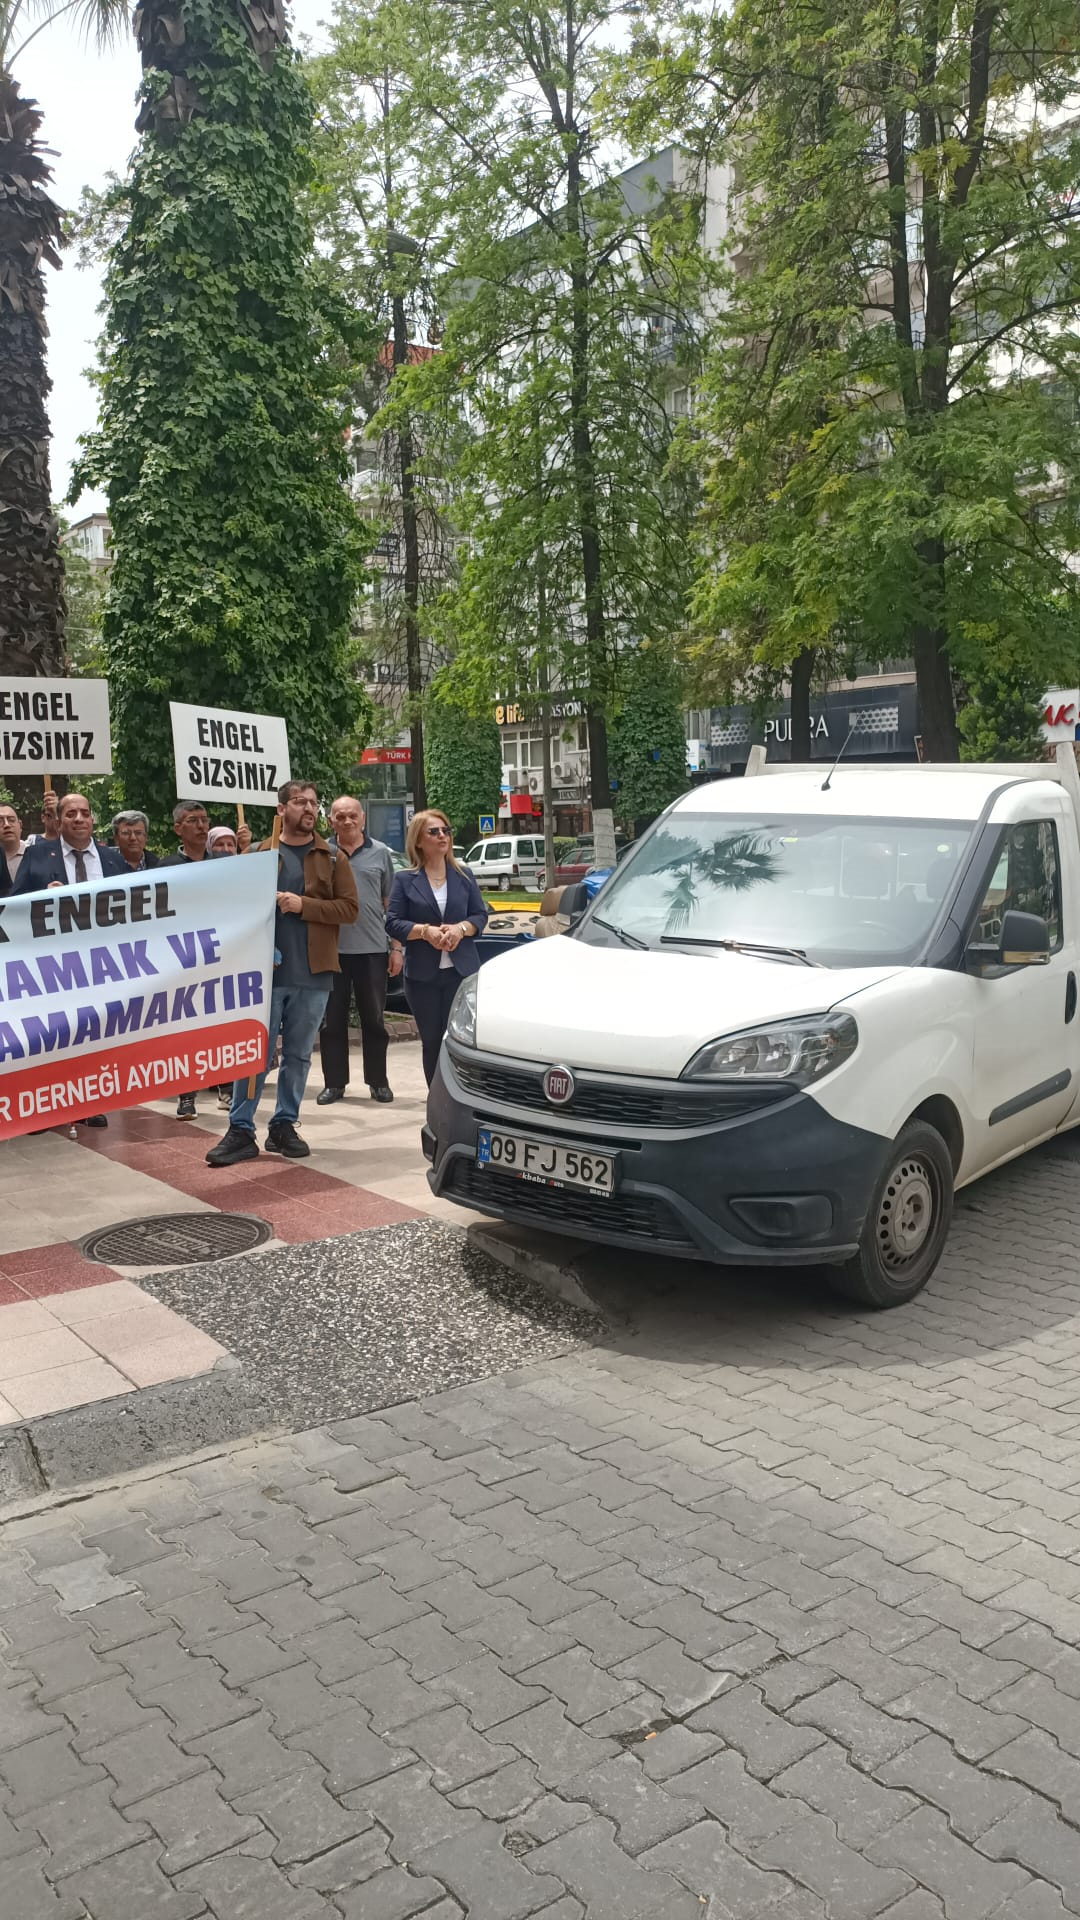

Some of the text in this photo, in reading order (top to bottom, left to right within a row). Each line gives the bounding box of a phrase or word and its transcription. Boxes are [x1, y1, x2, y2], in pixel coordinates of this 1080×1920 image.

[0, 691, 79, 721] ENGEL
[0, 731, 94, 760] İZSİNİZ
[197, 717, 264, 753] ENGEL
[386, 751, 406, 760] TÜRK
[31, 881, 176, 938] ENGEL
[0, 928, 221, 1001] AMAK VE
[18, 1063, 121, 1117] DERNEĞİ
[126, 1054, 190, 1092] AYDIN
[194, 1031, 262, 1081] ŞUBESİ
[549, 1076, 568, 1095] FIAT
[481, 1148, 489, 1156] TR
[490, 1136, 516, 1164] 09
[565, 1152, 608, 1186] 562
